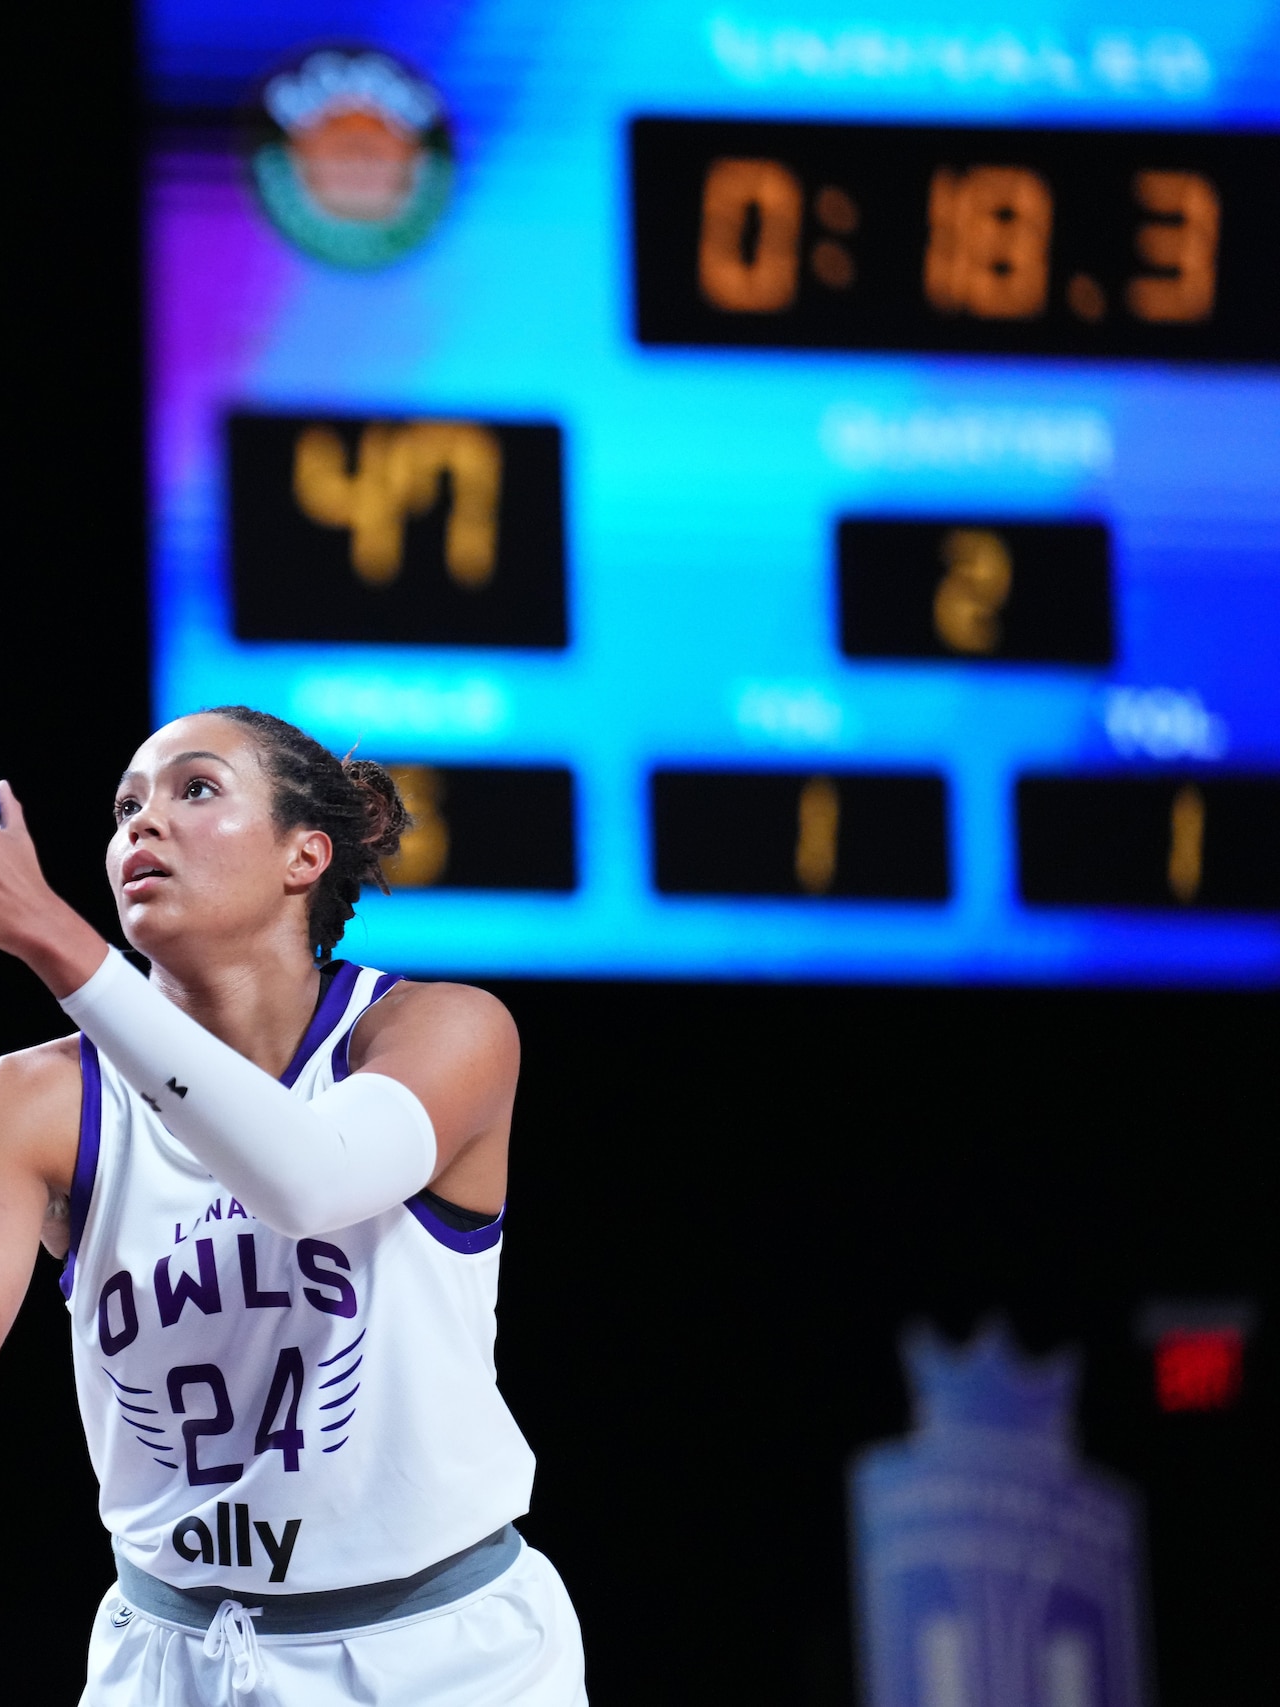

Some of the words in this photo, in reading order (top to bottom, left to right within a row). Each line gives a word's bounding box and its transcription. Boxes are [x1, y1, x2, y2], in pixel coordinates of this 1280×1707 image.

[293, 420, 502, 587] 47
[175, 1197, 257, 1244] LNA
[98, 1234, 357, 1357] OWLS
[166, 1346, 305, 1487] 24
[172, 1501, 302, 1583] ally
